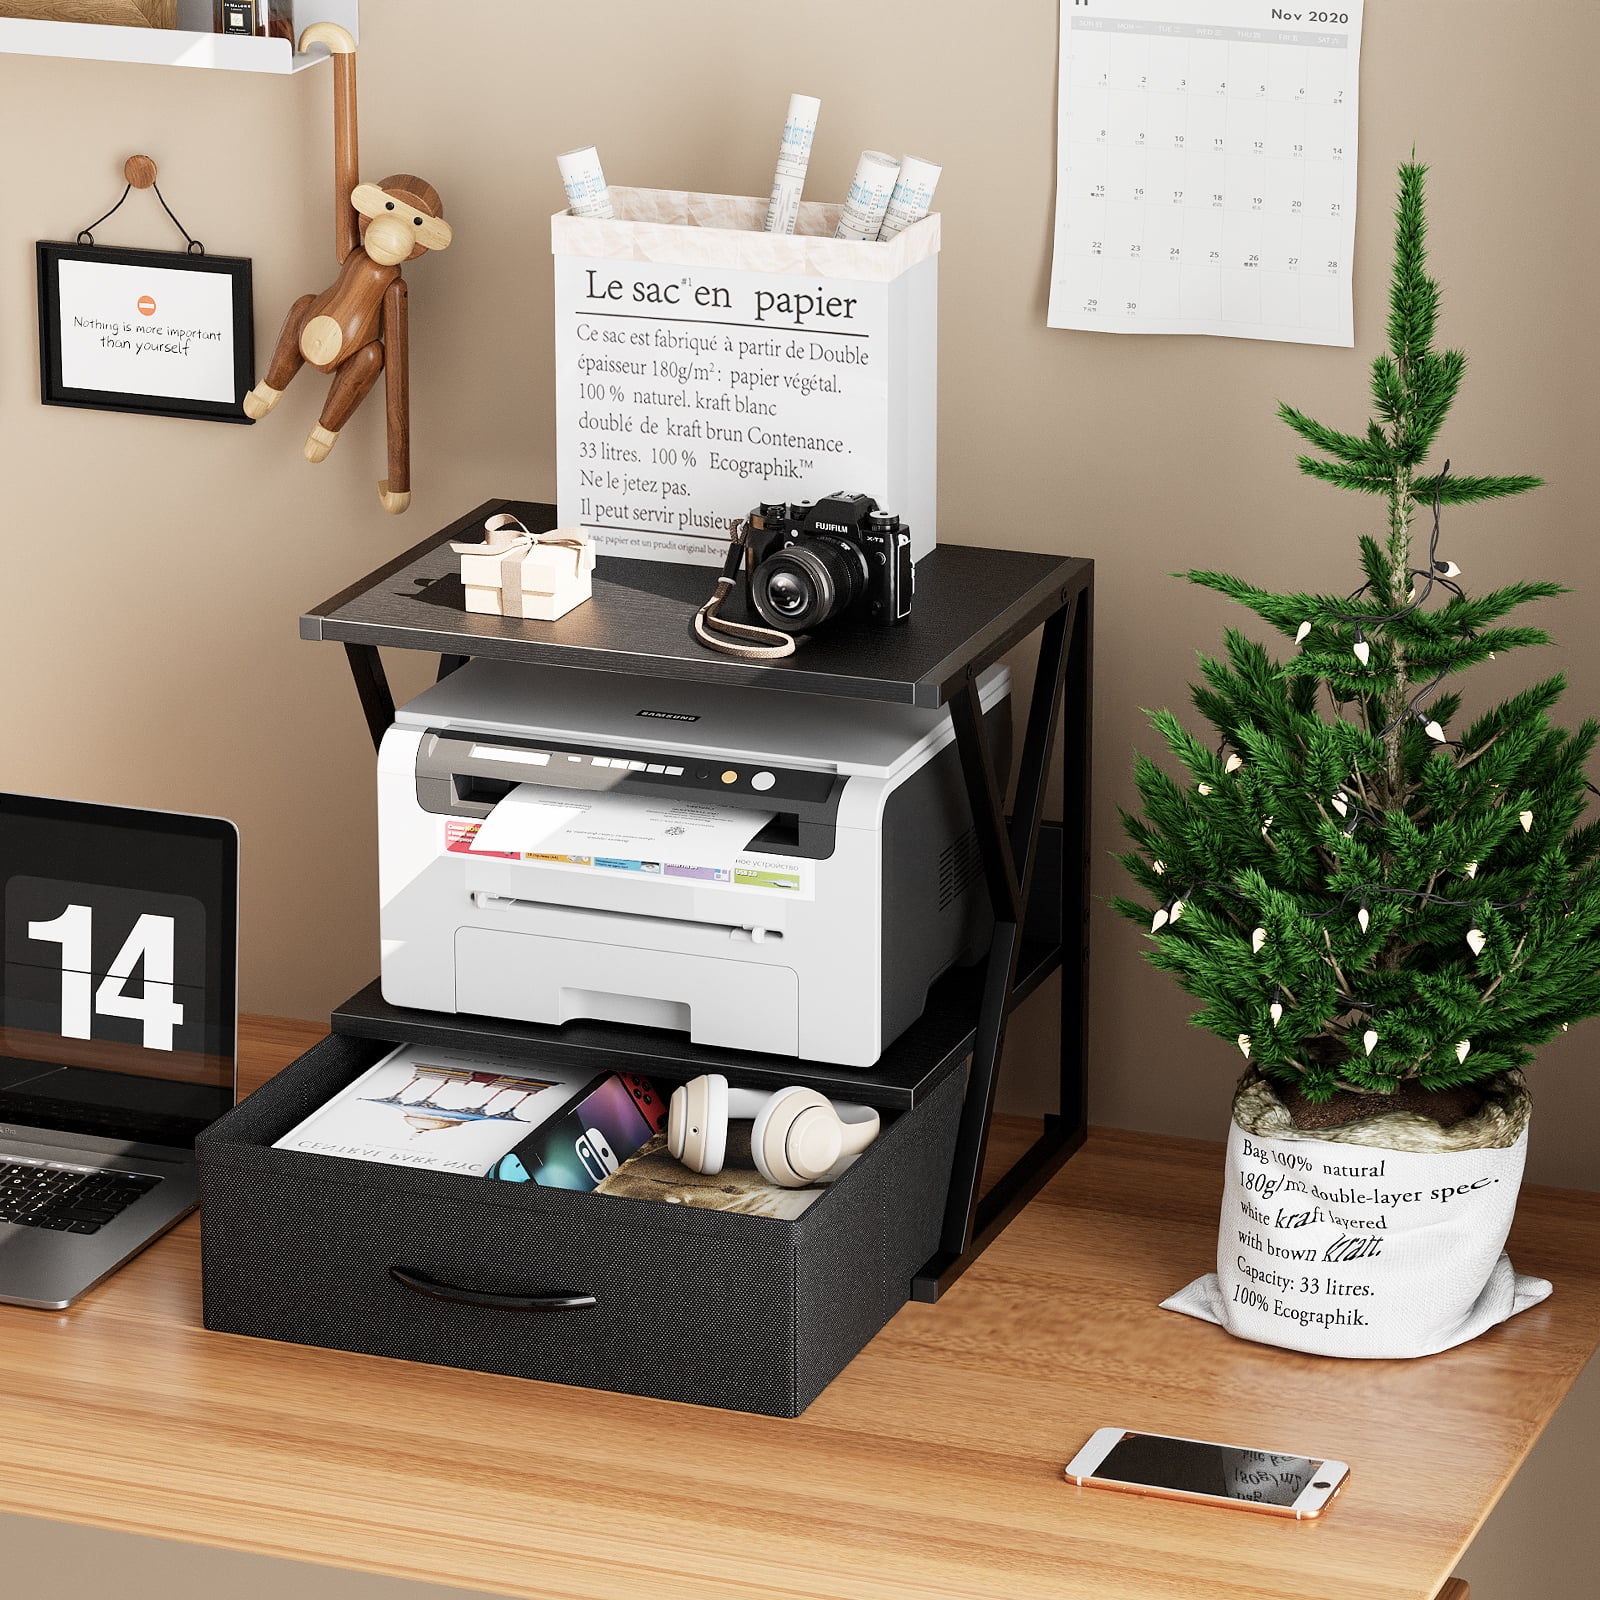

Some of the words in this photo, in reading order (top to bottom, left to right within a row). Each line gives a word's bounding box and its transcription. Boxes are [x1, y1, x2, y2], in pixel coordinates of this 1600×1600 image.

[1272, 9, 1302, 20] Nov
[1309, 11, 1348, 24] 2020
[586, 269, 623, 300] Le
[695, 286, 732, 308] en
[754, 286, 857, 325] papier
[74, 316, 119, 336] Nothing
[123, 322, 132, 332] is
[136, 325, 162, 336] more
[167, 326, 222, 341] important
[100, 336, 130, 349] than
[136, 338, 190, 356] yourself
[576, 323, 599, 341] Ce
[602, 329, 626, 344] sac
[630, 331, 650, 346] est
[654, 328, 718, 356] fabriqué
[724, 335, 734, 352] à
[739, 338, 782, 360] partir
[786, 340, 805, 359] de
[810, 342, 869, 366] Double
[578, 354, 647, 376] épaisseur
[730, 368, 780, 391] papier
[783, 372, 842, 397] végétal.
[580, 382, 606, 400] 100
[610, 384, 625, 402] %
[633, 389, 691, 408] naturel.
[696, 390, 731, 412] kraft
[735, 394, 777, 416] blanc
[578, 410, 633, 433] doublé
[640, 416, 659, 434] de
[666, 418, 702, 438] kraft
[706, 420, 742, 443] brun
[748, 426, 844, 453] Contenance
[580, 442, 597, 458] 33
[601, 442, 641, 462] litres.
[652, 448, 678, 466] 100
[682, 450, 696, 468] %
[580, 470, 603, 488] Ne
[607, 471, 620, 490] le
[623, 474, 658, 496] jetez
[662, 481, 691, 500] pas.
[581, 498, 590, 516] Il
[596, 504, 629, 522] peut
[632, 506, 674, 524] servir
[606, 536, 628, 546] papier
[815, 522, 848, 533] FUJIFILM
[28, 904, 184, 1052] 14
[1244, 1139, 1269, 1164] Bag
[1272, 1150, 1313, 1172] 100%
[1323, 1160, 1386, 1177] natural
[1311, 1185, 1422, 1208] double-layer
[1430, 1177, 1500, 1202] spec.
[1240, 1201, 1270, 1226] white
[1274, 1206, 1324, 1229] kraft
[1328, 1210, 1388, 1230] layered
[1238, 1230, 1262, 1252] with
[1268, 1239, 1316, 1262] brown
[1237, 1256, 1294, 1291] Capacity:
[1300, 1277, 1320, 1294] 33
[1326, 1279, 1375, 1296] litres.
[1233, 1284, 1270, 1312] 100%
[1274, 1300, 1369, 1330] Ecographik.
